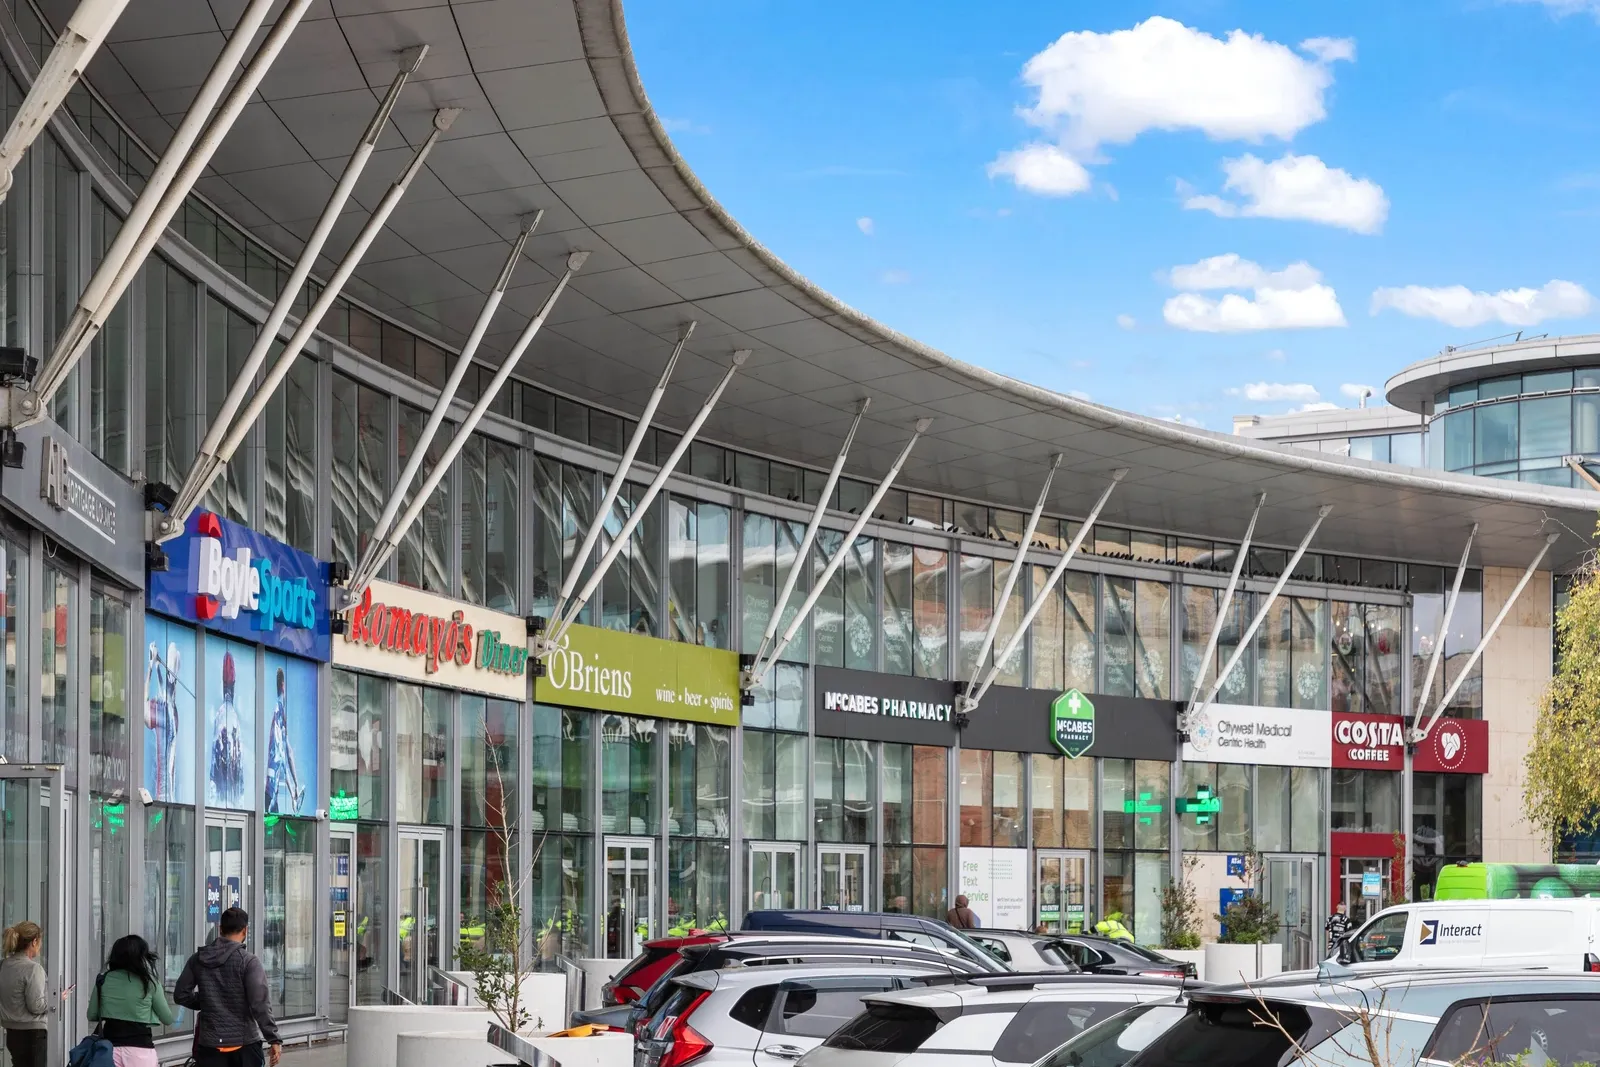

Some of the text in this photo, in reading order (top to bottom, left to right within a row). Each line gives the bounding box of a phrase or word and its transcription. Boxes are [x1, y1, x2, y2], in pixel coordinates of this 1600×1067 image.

[476, 629, 529, 676] Diner
[656, 684, 733, 713] wine beer spirits
[882, 698, 952, 721] PHARMACY
[1218, 720, 1292, 737] Citywest Medical
[1335, 720, 1404, 748] COSTA
[1218, 737, 1267, 749] Centric Health
[1348, 748, 1389, 761] COFFEE
[962, 861, 979, 872] Free
[962, 876, 978, 887] Text
[1440, 924, 1482, 937] Interact
